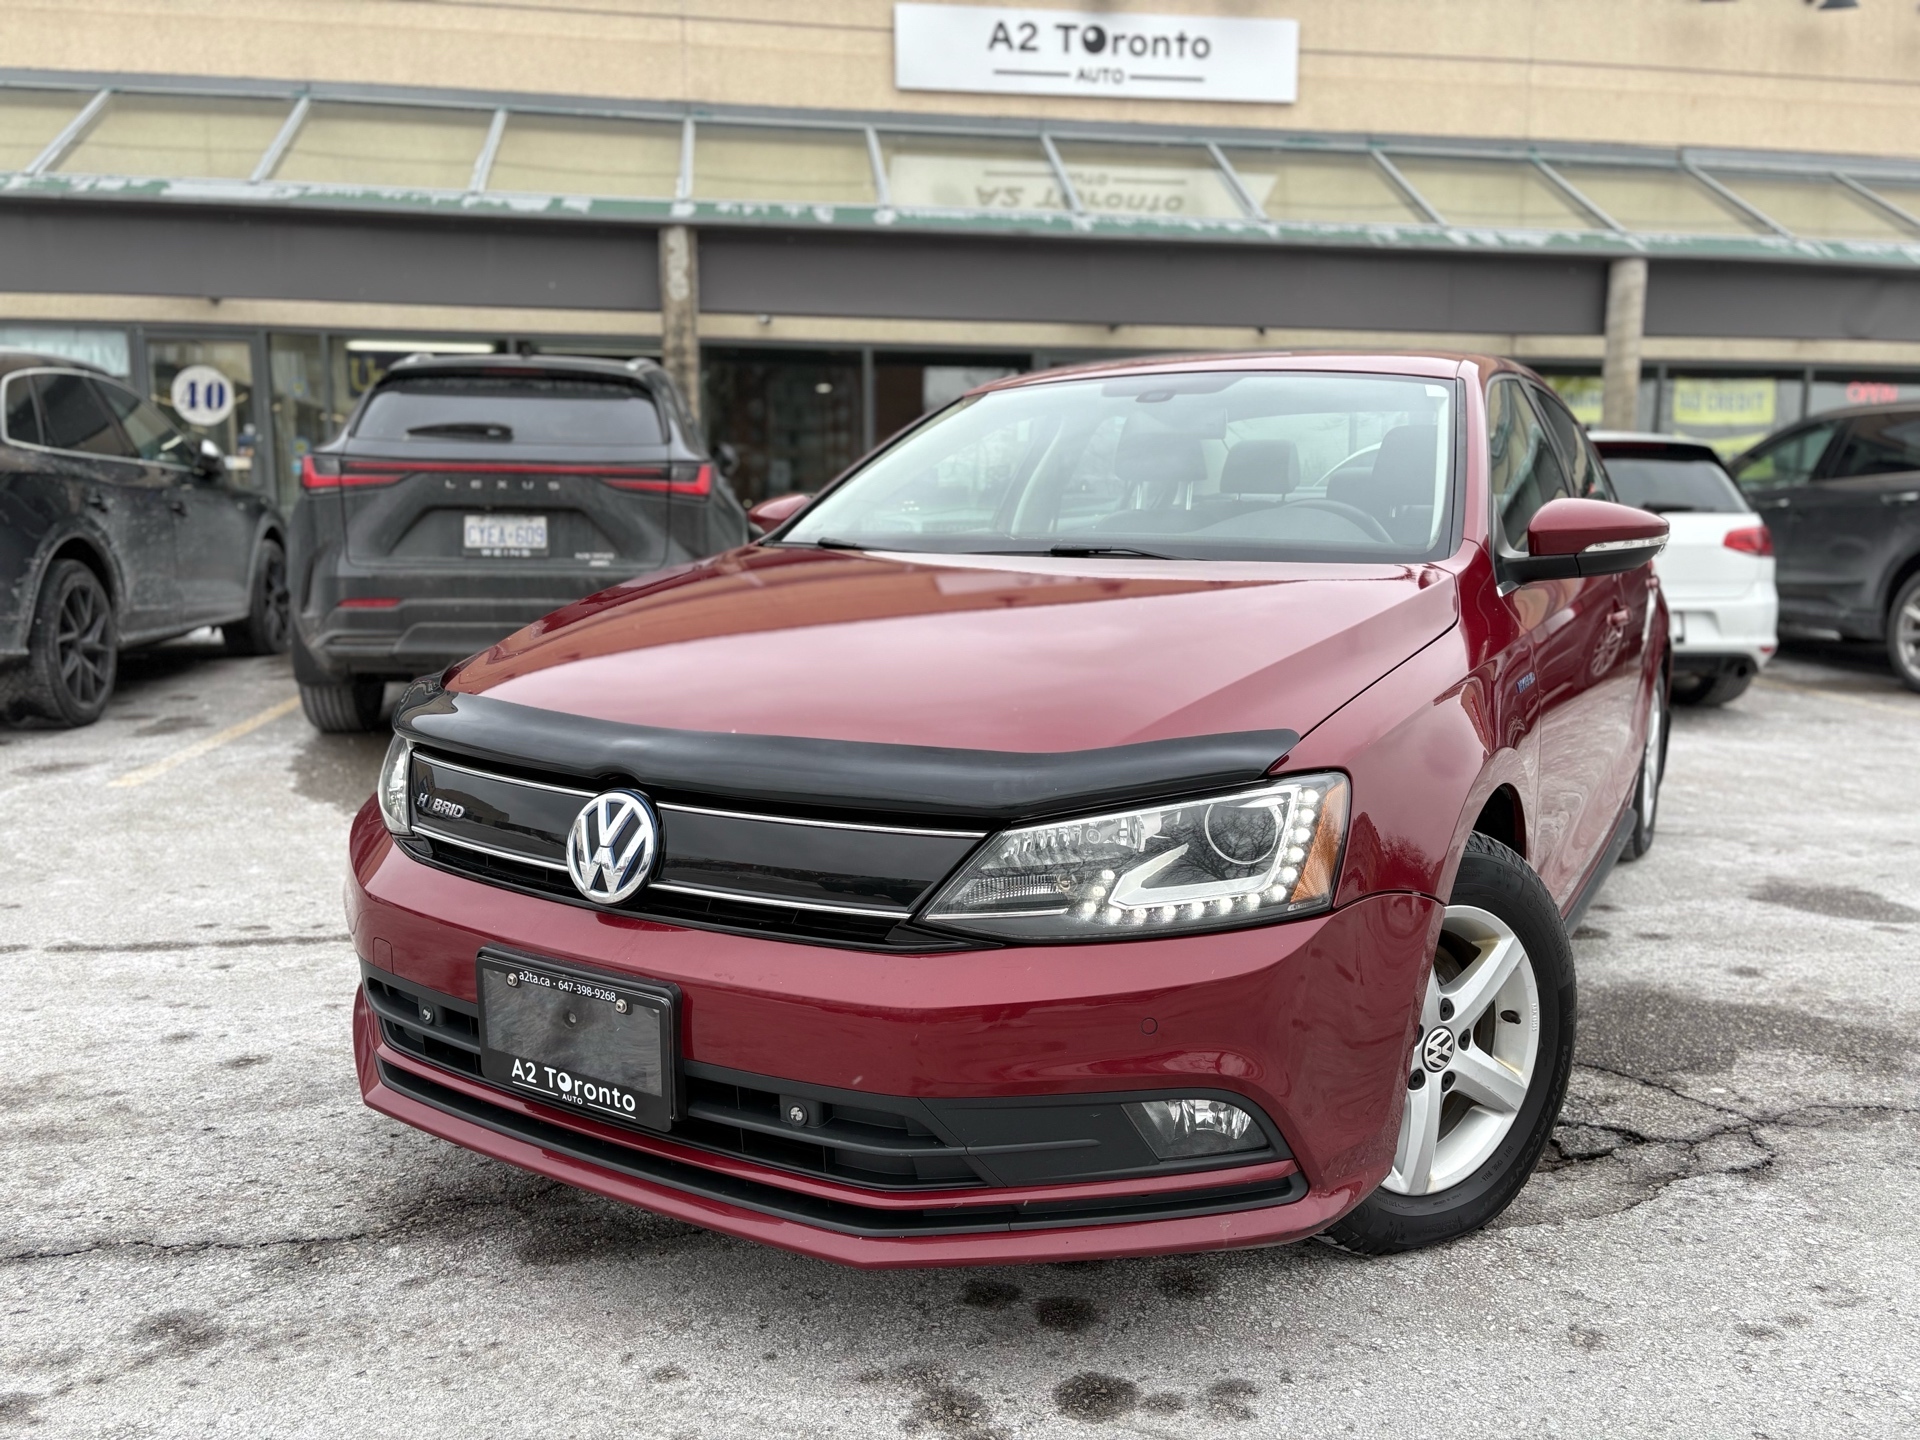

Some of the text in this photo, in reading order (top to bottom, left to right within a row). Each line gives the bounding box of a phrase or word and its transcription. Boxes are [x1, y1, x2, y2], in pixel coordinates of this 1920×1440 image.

[987, 20, 1040, 52] A2
[1075, 67, 1126, 85] AUTO
[444, 479, 561, 491] LEXUS
[518, 970, 617, 1003] a2ta.ca 647-398-9268
[511, 1058, 538, 1084] A2
[561, 1092, 584, 1106] AUTO
